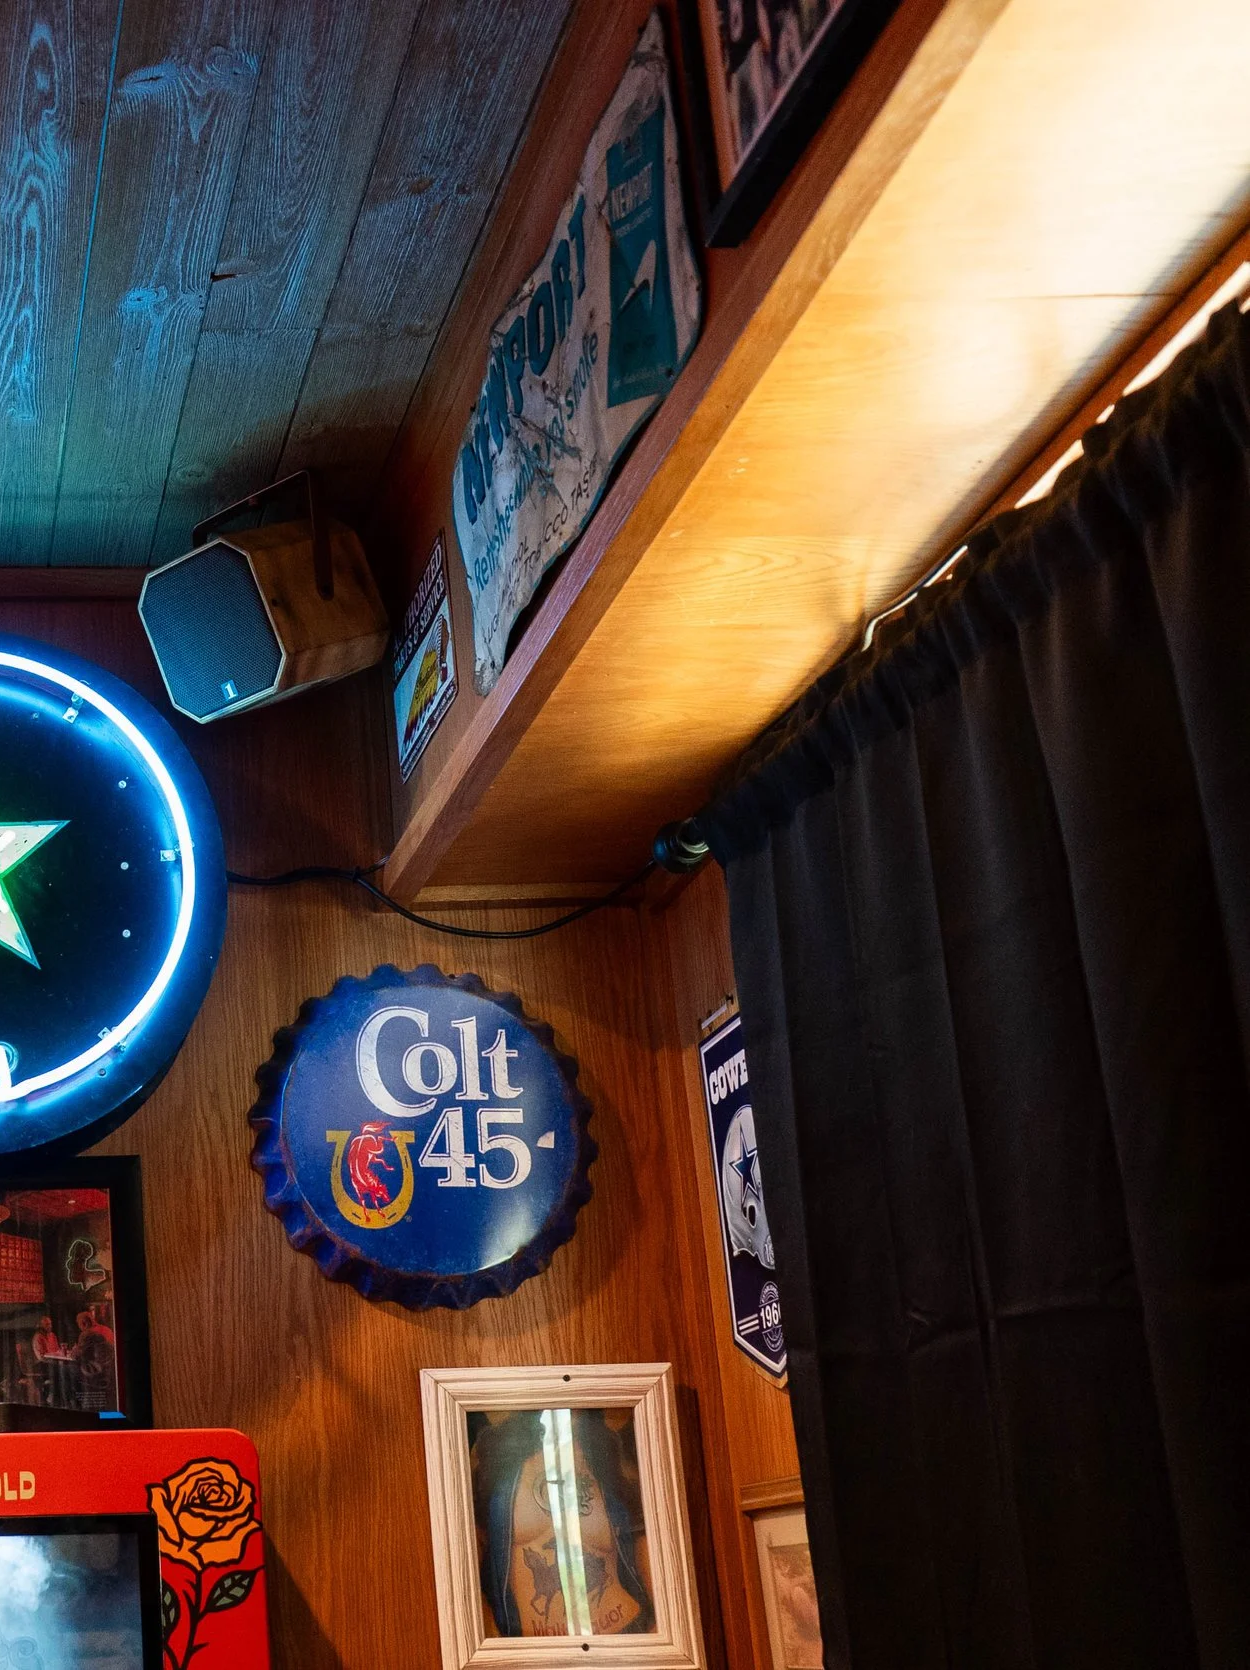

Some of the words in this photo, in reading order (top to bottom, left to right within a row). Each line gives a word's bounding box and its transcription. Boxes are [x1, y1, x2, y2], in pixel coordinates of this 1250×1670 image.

[462, 194, 586, 525] NEWPORT
[565, 331, 598, 420] smoke
[225, 683, 236, 699] 1
[356, 1006, 523, 1117] Colt
[418, 1107, 532, 1189] 45
